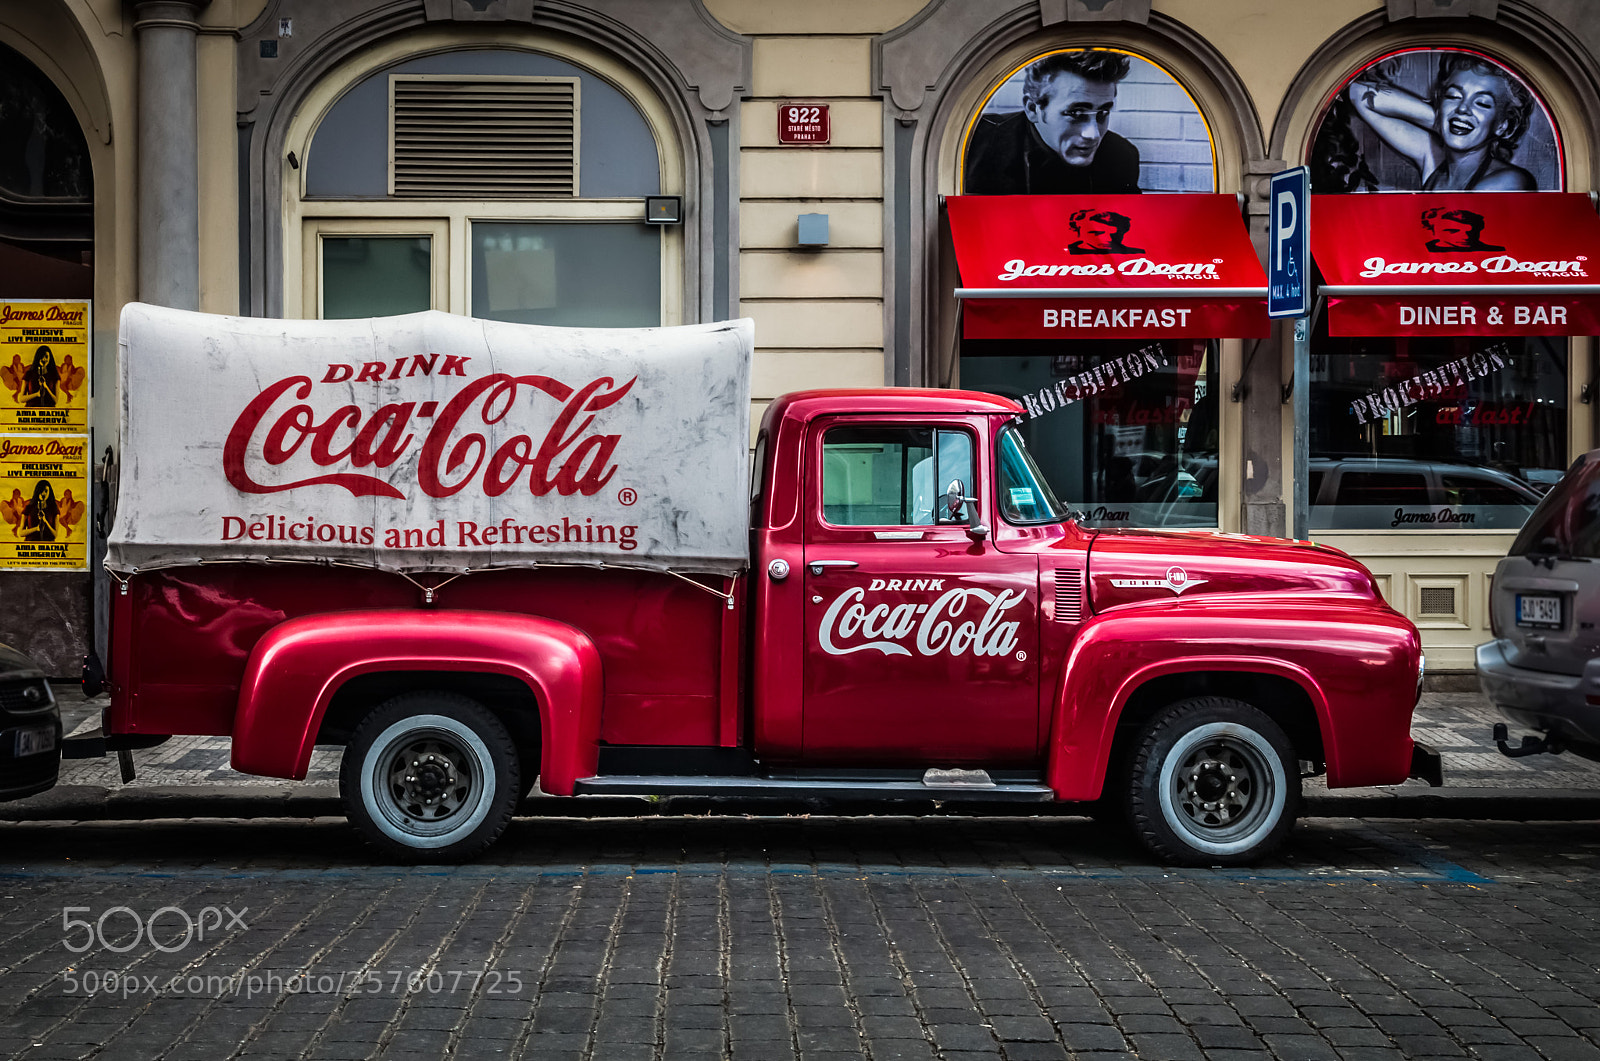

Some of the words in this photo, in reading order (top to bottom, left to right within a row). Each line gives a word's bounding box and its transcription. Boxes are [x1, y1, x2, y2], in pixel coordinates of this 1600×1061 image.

[788, 107, 820, 123] 922
[788, 124, 803, 132] STARÉ
[804, 124, 821, 132] MĚSTO
[1277, 190, 1298, 271] P
[997, 258, 1115, 281] James
[1117, 257, 1218, 277] Dean
[1359, 256, 1478, 279] James
[1480, 254, 1584, 274] Dean
[0, 305, 44, 325] James
[45, 305, 83, 321] Dean
[1043, 308, 1192, 328] BREAKFAST
[1399, 306, 1477, 325] DINER
[1486, 306, 1504, 325] &
[1514, 306, 1568, 325] BAR
[320, 353, 472, 384] DRINK
[1350, 341, 1515, 425] PROHIBITION!
[1436, 405, 1464, 425] at
[1471, 399, 1535, 425] last!
[222, 373, 638, 501] Coca-Cola
[0, 439, 44, 459] James
[45, 440, 83, 456] Dean
[1092, 506, 1130, 521] Dean
[1390, 507, 1437, 527] James
[1437, 507, 1476, 523] Dean
[219, 514, 375, 546] Delicious
[384, 519, 446, 549] and
[456, 516, 639, 551] Refreshing
[868, 578, 946, 592] DRINK
[818, 586, 1028, 657] Coca-Cola
